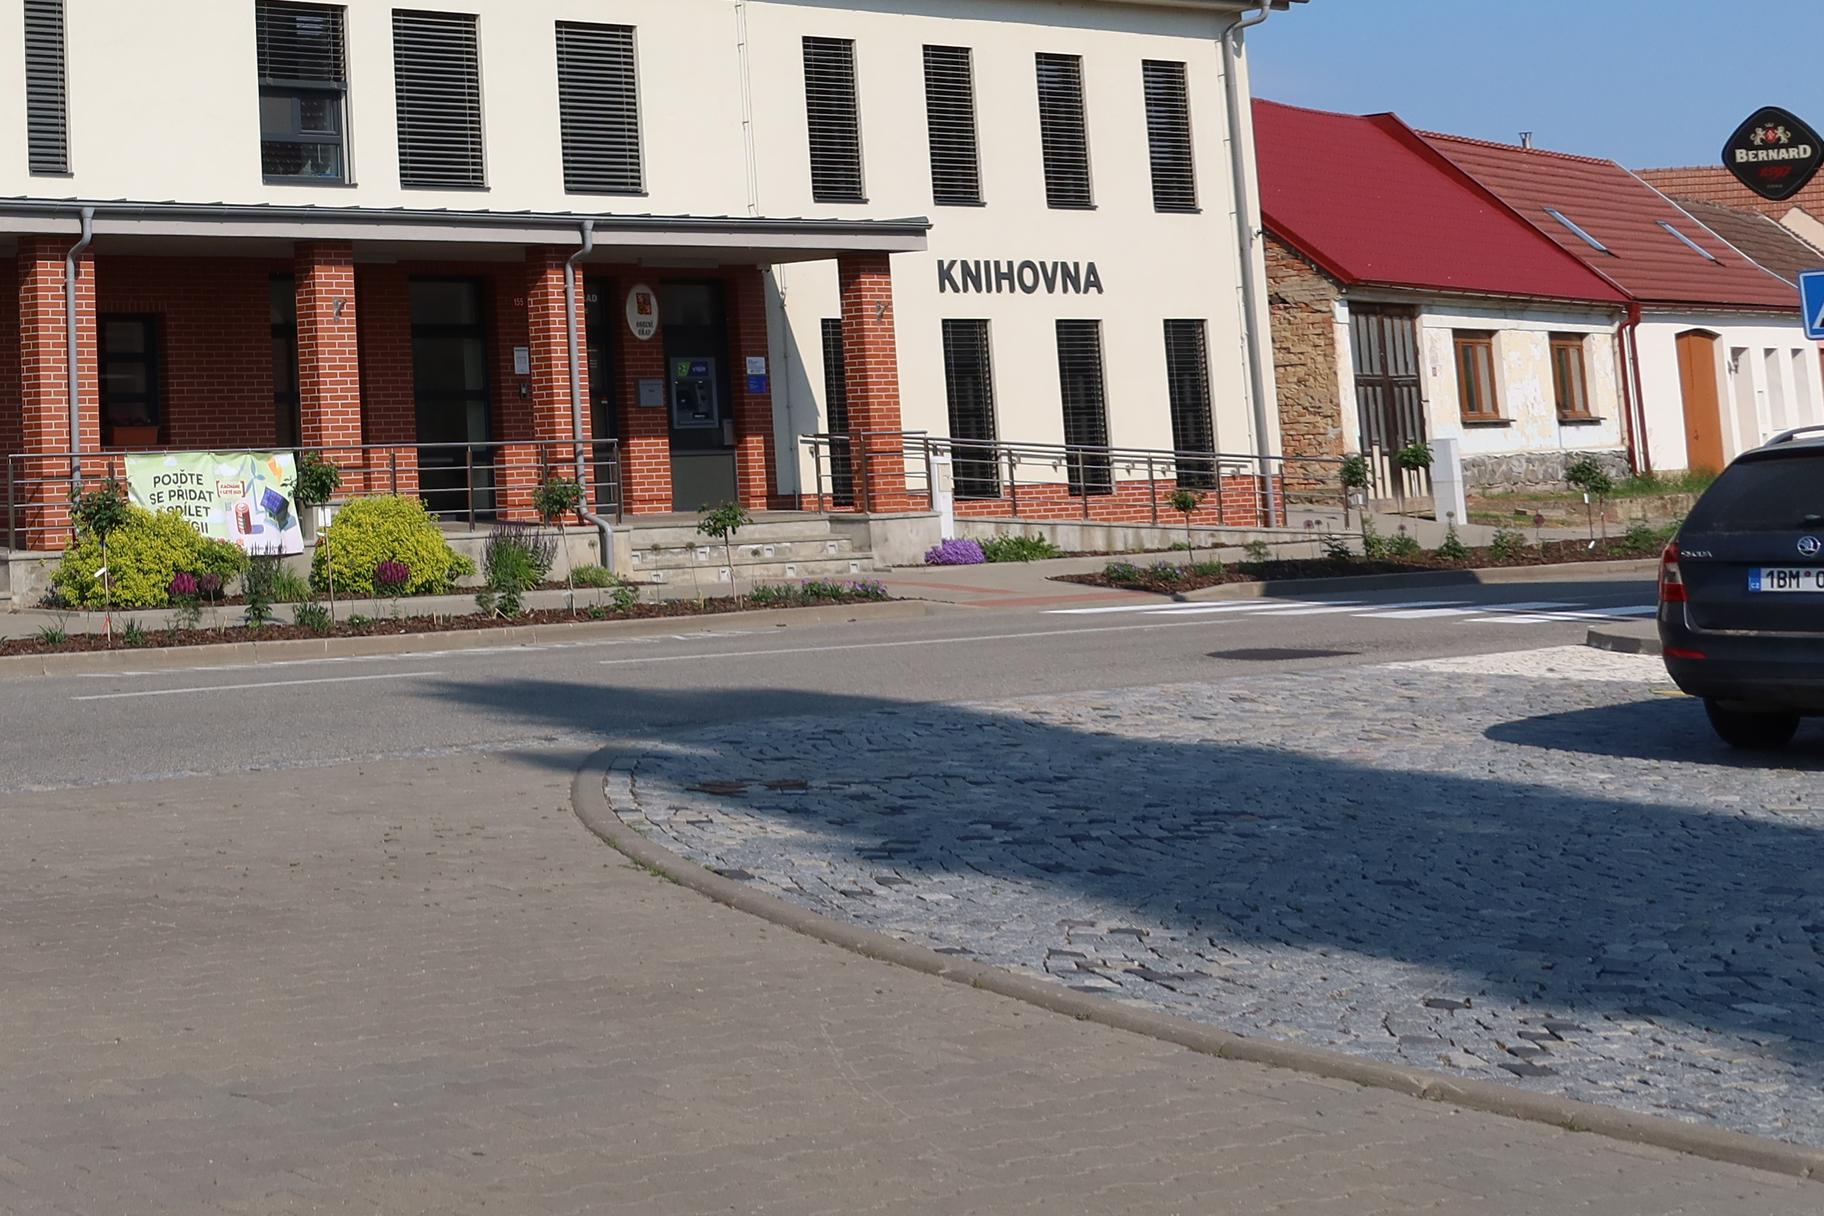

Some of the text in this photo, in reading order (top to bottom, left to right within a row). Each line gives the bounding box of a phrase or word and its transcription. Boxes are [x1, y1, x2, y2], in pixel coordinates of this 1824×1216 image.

[1734, 144, 1812, 163] BERNARD
[937, 259, 1104, 295] KNIHOVNA
[586, 294, 598, 303] AD
[153, 469, 204, 488] POJĎTE
[149, 485, 214, 505] SE PŘIDAT
[1766, 570, 1801, 589] 1BM
